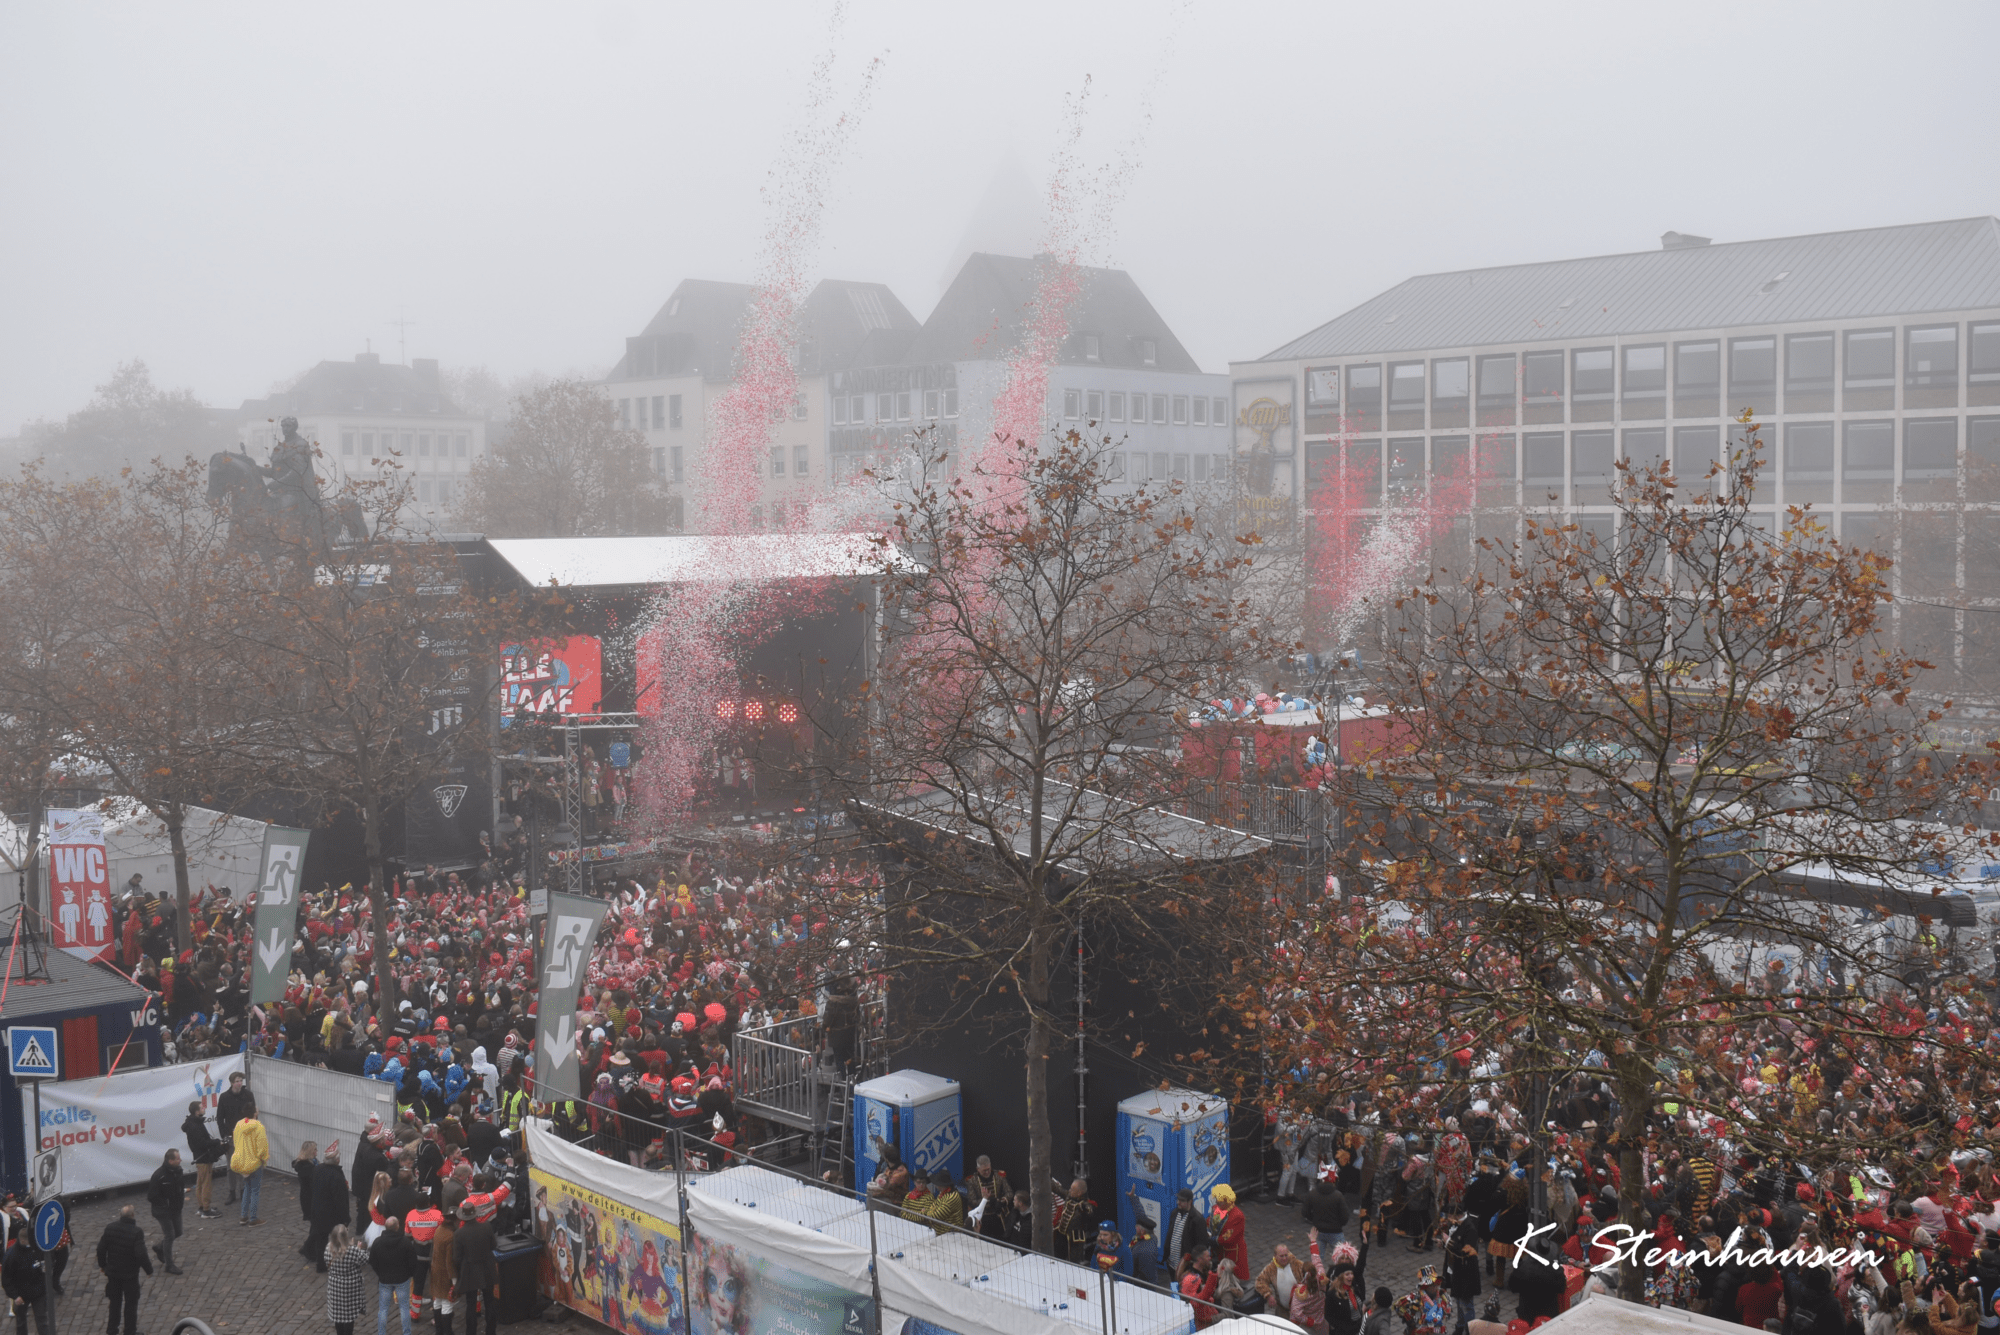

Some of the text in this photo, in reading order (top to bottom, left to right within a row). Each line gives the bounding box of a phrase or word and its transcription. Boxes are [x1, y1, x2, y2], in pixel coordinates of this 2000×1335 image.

[54, 847, 105, 884] WC
[130, 1008, 158, 1027] WC
[40, 1105, 97, 1127] Kölle,
[41, 1119, 146, 1149] alaaf you!
[561, 1183, 642, 1224] www.deiters.de
